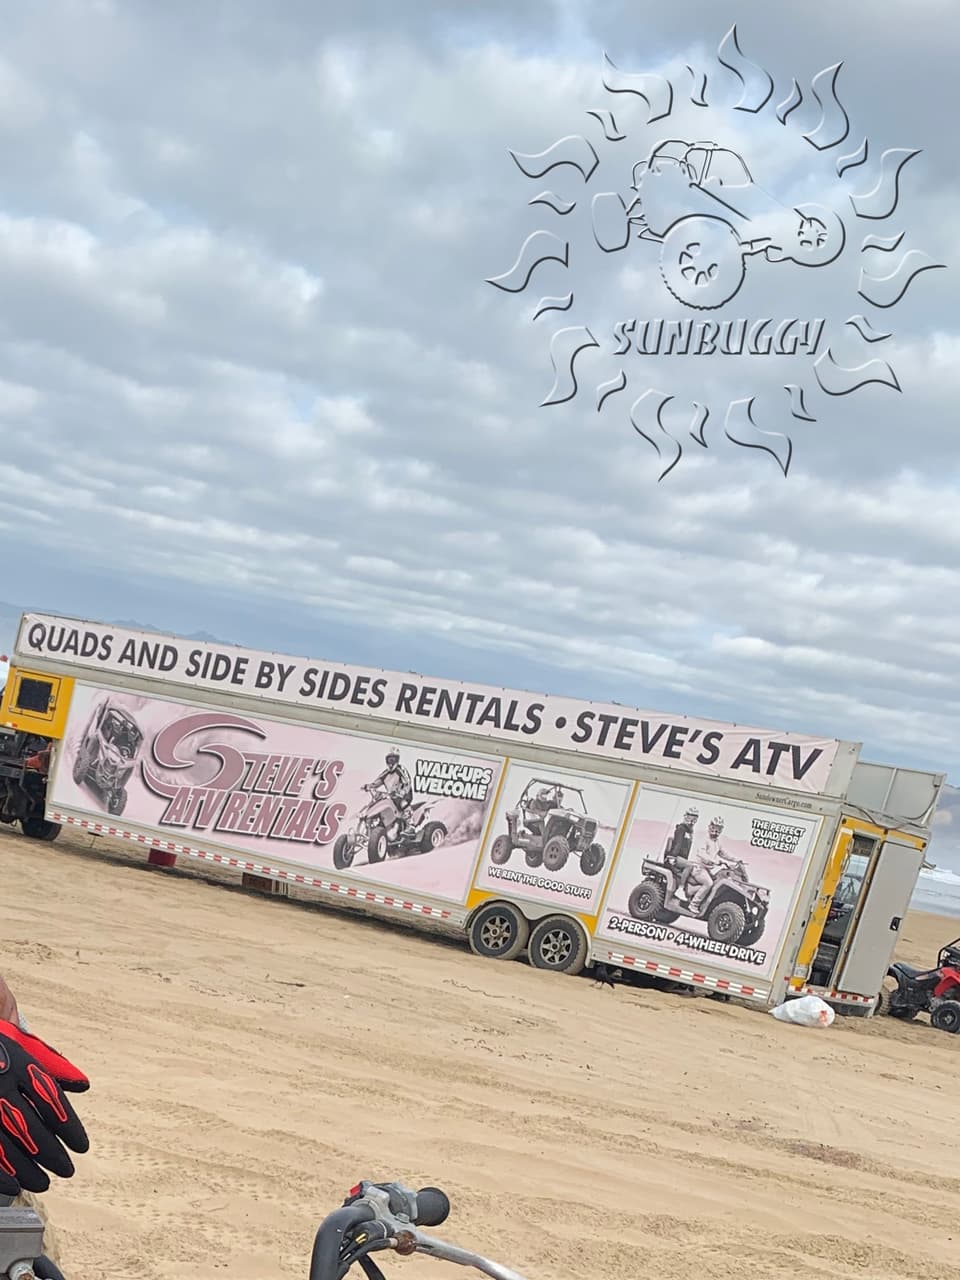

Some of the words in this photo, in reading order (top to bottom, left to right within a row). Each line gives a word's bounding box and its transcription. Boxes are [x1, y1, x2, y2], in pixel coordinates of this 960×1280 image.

[27, 623, 114, 662] QUADS
[117, 639, 178, 672] AND
[185, 650, 249, 686] SIDE
[254, 661, 296, 692] BY
[299, 668, 388, 708] SIDES
[395, 683, 545, 735] RENTALS
[570, 711, 723, 765] STEVE'S
[730, 738, 823, 780] ATV
[416, 759, 493, 785] WALK-UPS
[415, 775, 488, 801] WELCOME
[159, 786, 227, 830] ATV
[213, 791, 347, 845] RENTALS
[752, 818, 770, 830] THE
[770, 822, 806, 837] PERFECT
[751, 837, 796, 853] COUPLES!!
[753, 828, 780, 841] QUAD
[780, 832, 799, 845] FOR
[488, 866, 501, 878] WE
[501, 868, 521, 883] RENT
[521, 873, 537, 886] THE
[537, 878, 564, 893] GOOD
[565, 884, 592, 899] STUFF!
[608, 916, 667, 942] 2-PERSON
[675, 932, 729, 956] 4-WHEEL
[729, 944, 767, 966] DRIVE
